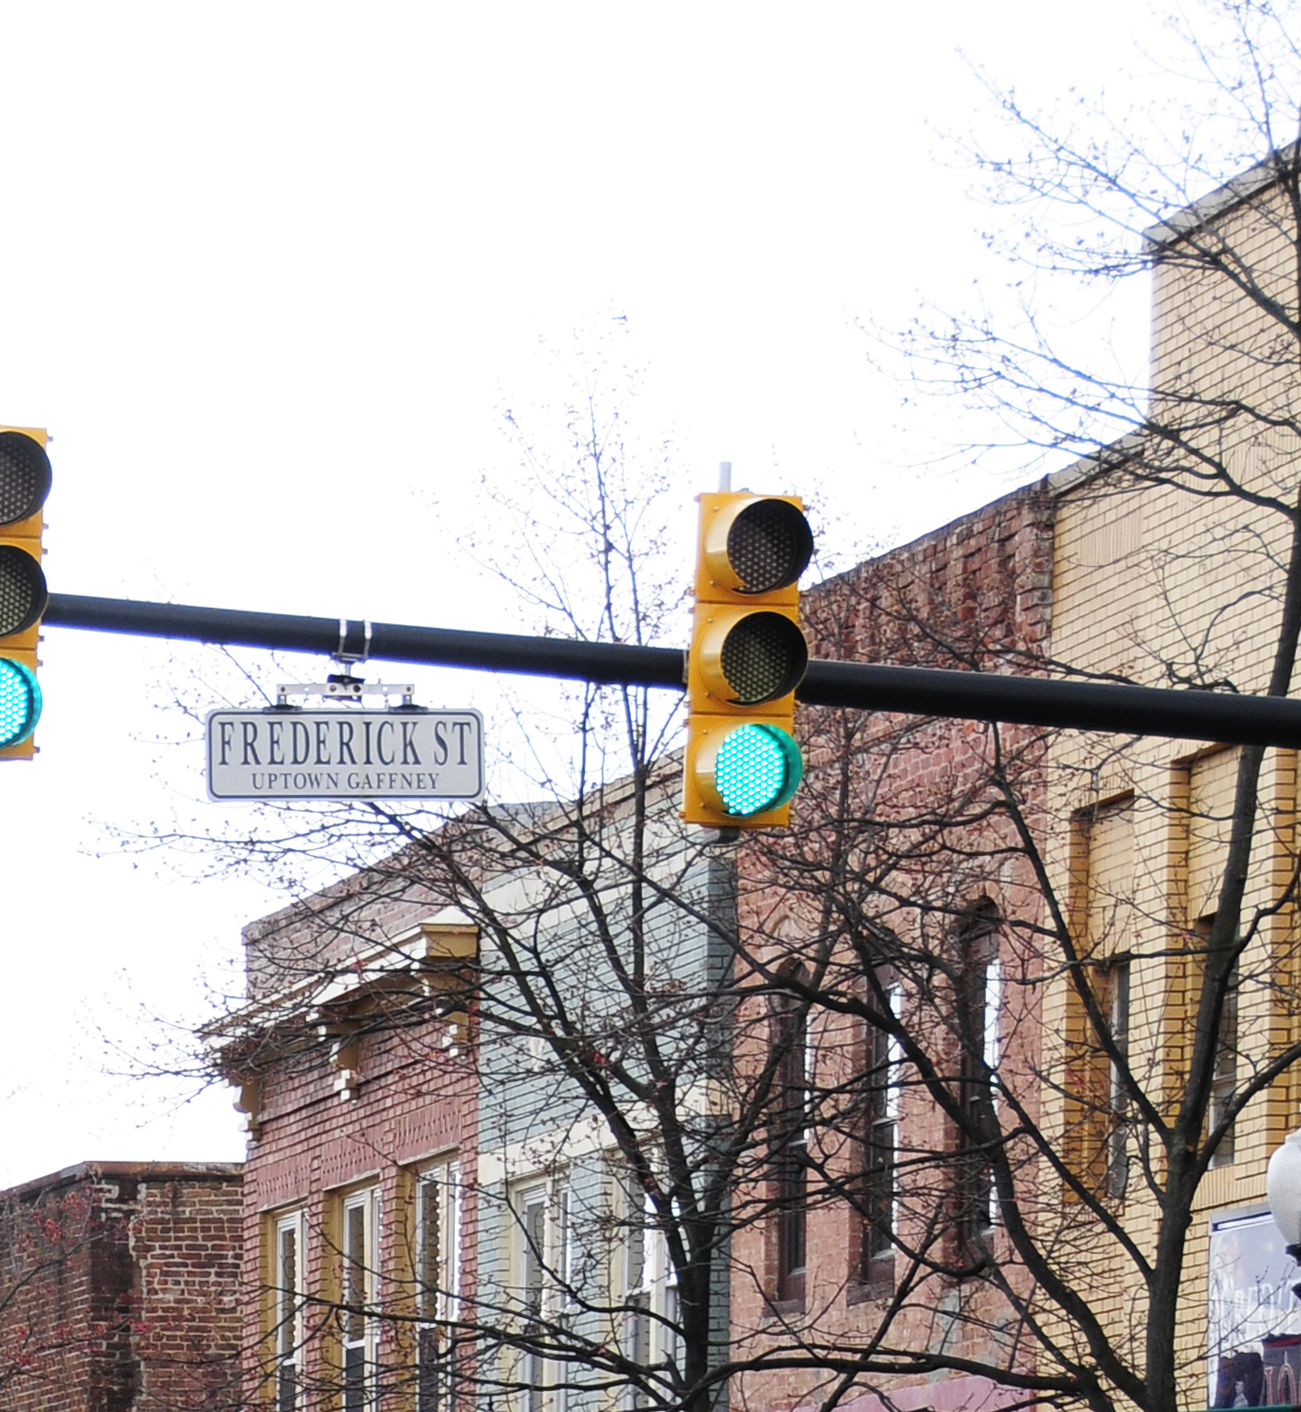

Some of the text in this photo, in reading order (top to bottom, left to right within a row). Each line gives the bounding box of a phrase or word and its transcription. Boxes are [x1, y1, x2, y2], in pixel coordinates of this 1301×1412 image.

[217, 720, 473, 766] FREDERICK ST
[251, 772, 440, 790] UPTOWN GAFFNEY
